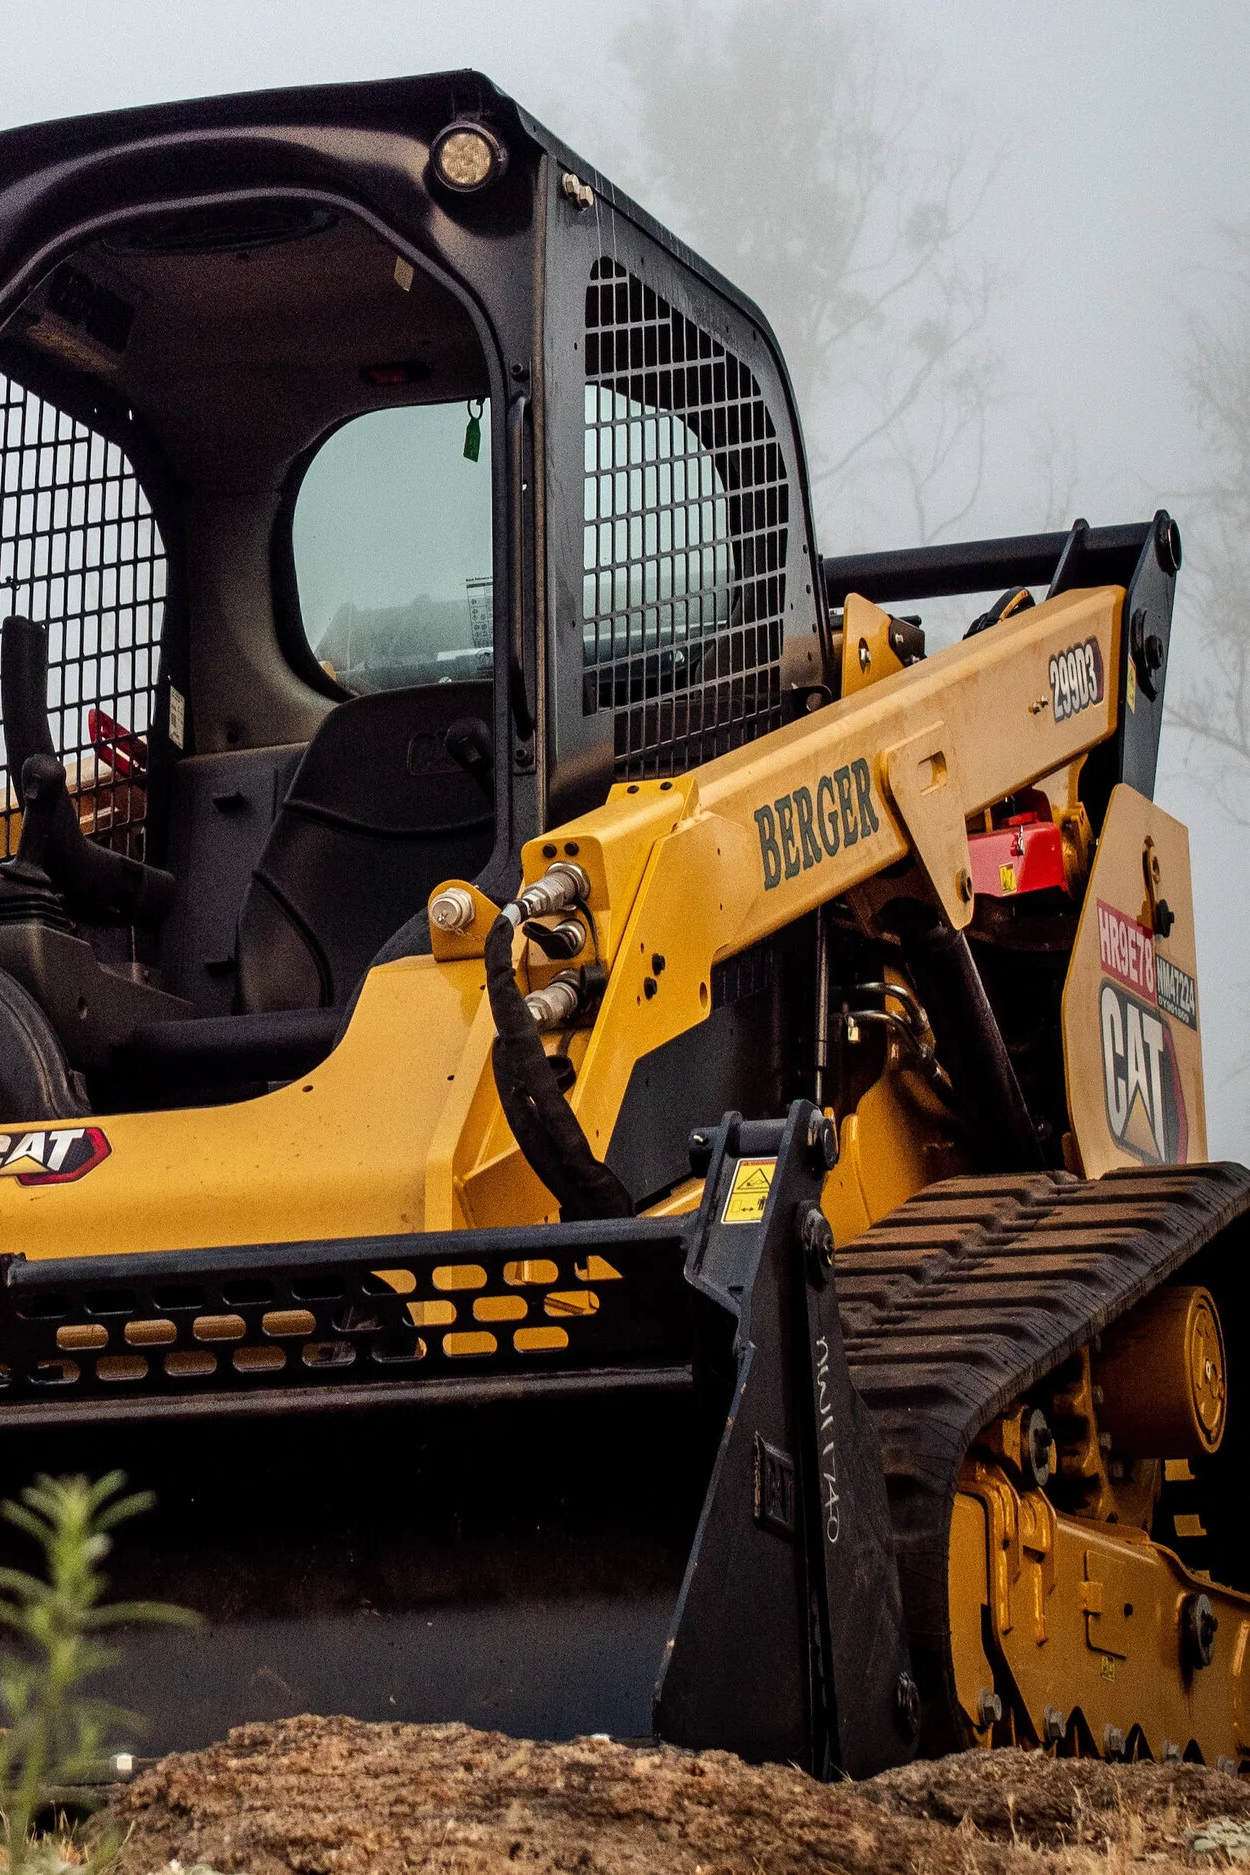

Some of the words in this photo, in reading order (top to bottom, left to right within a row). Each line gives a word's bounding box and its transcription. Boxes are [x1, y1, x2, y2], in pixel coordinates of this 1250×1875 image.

[1049, 642, 1099, 719] 299D3
[754, 757, 879, 891] BERGER
[1098, 906, 1154, 993] HR9E78
[1101, 986, 1166, 1162] CAT
